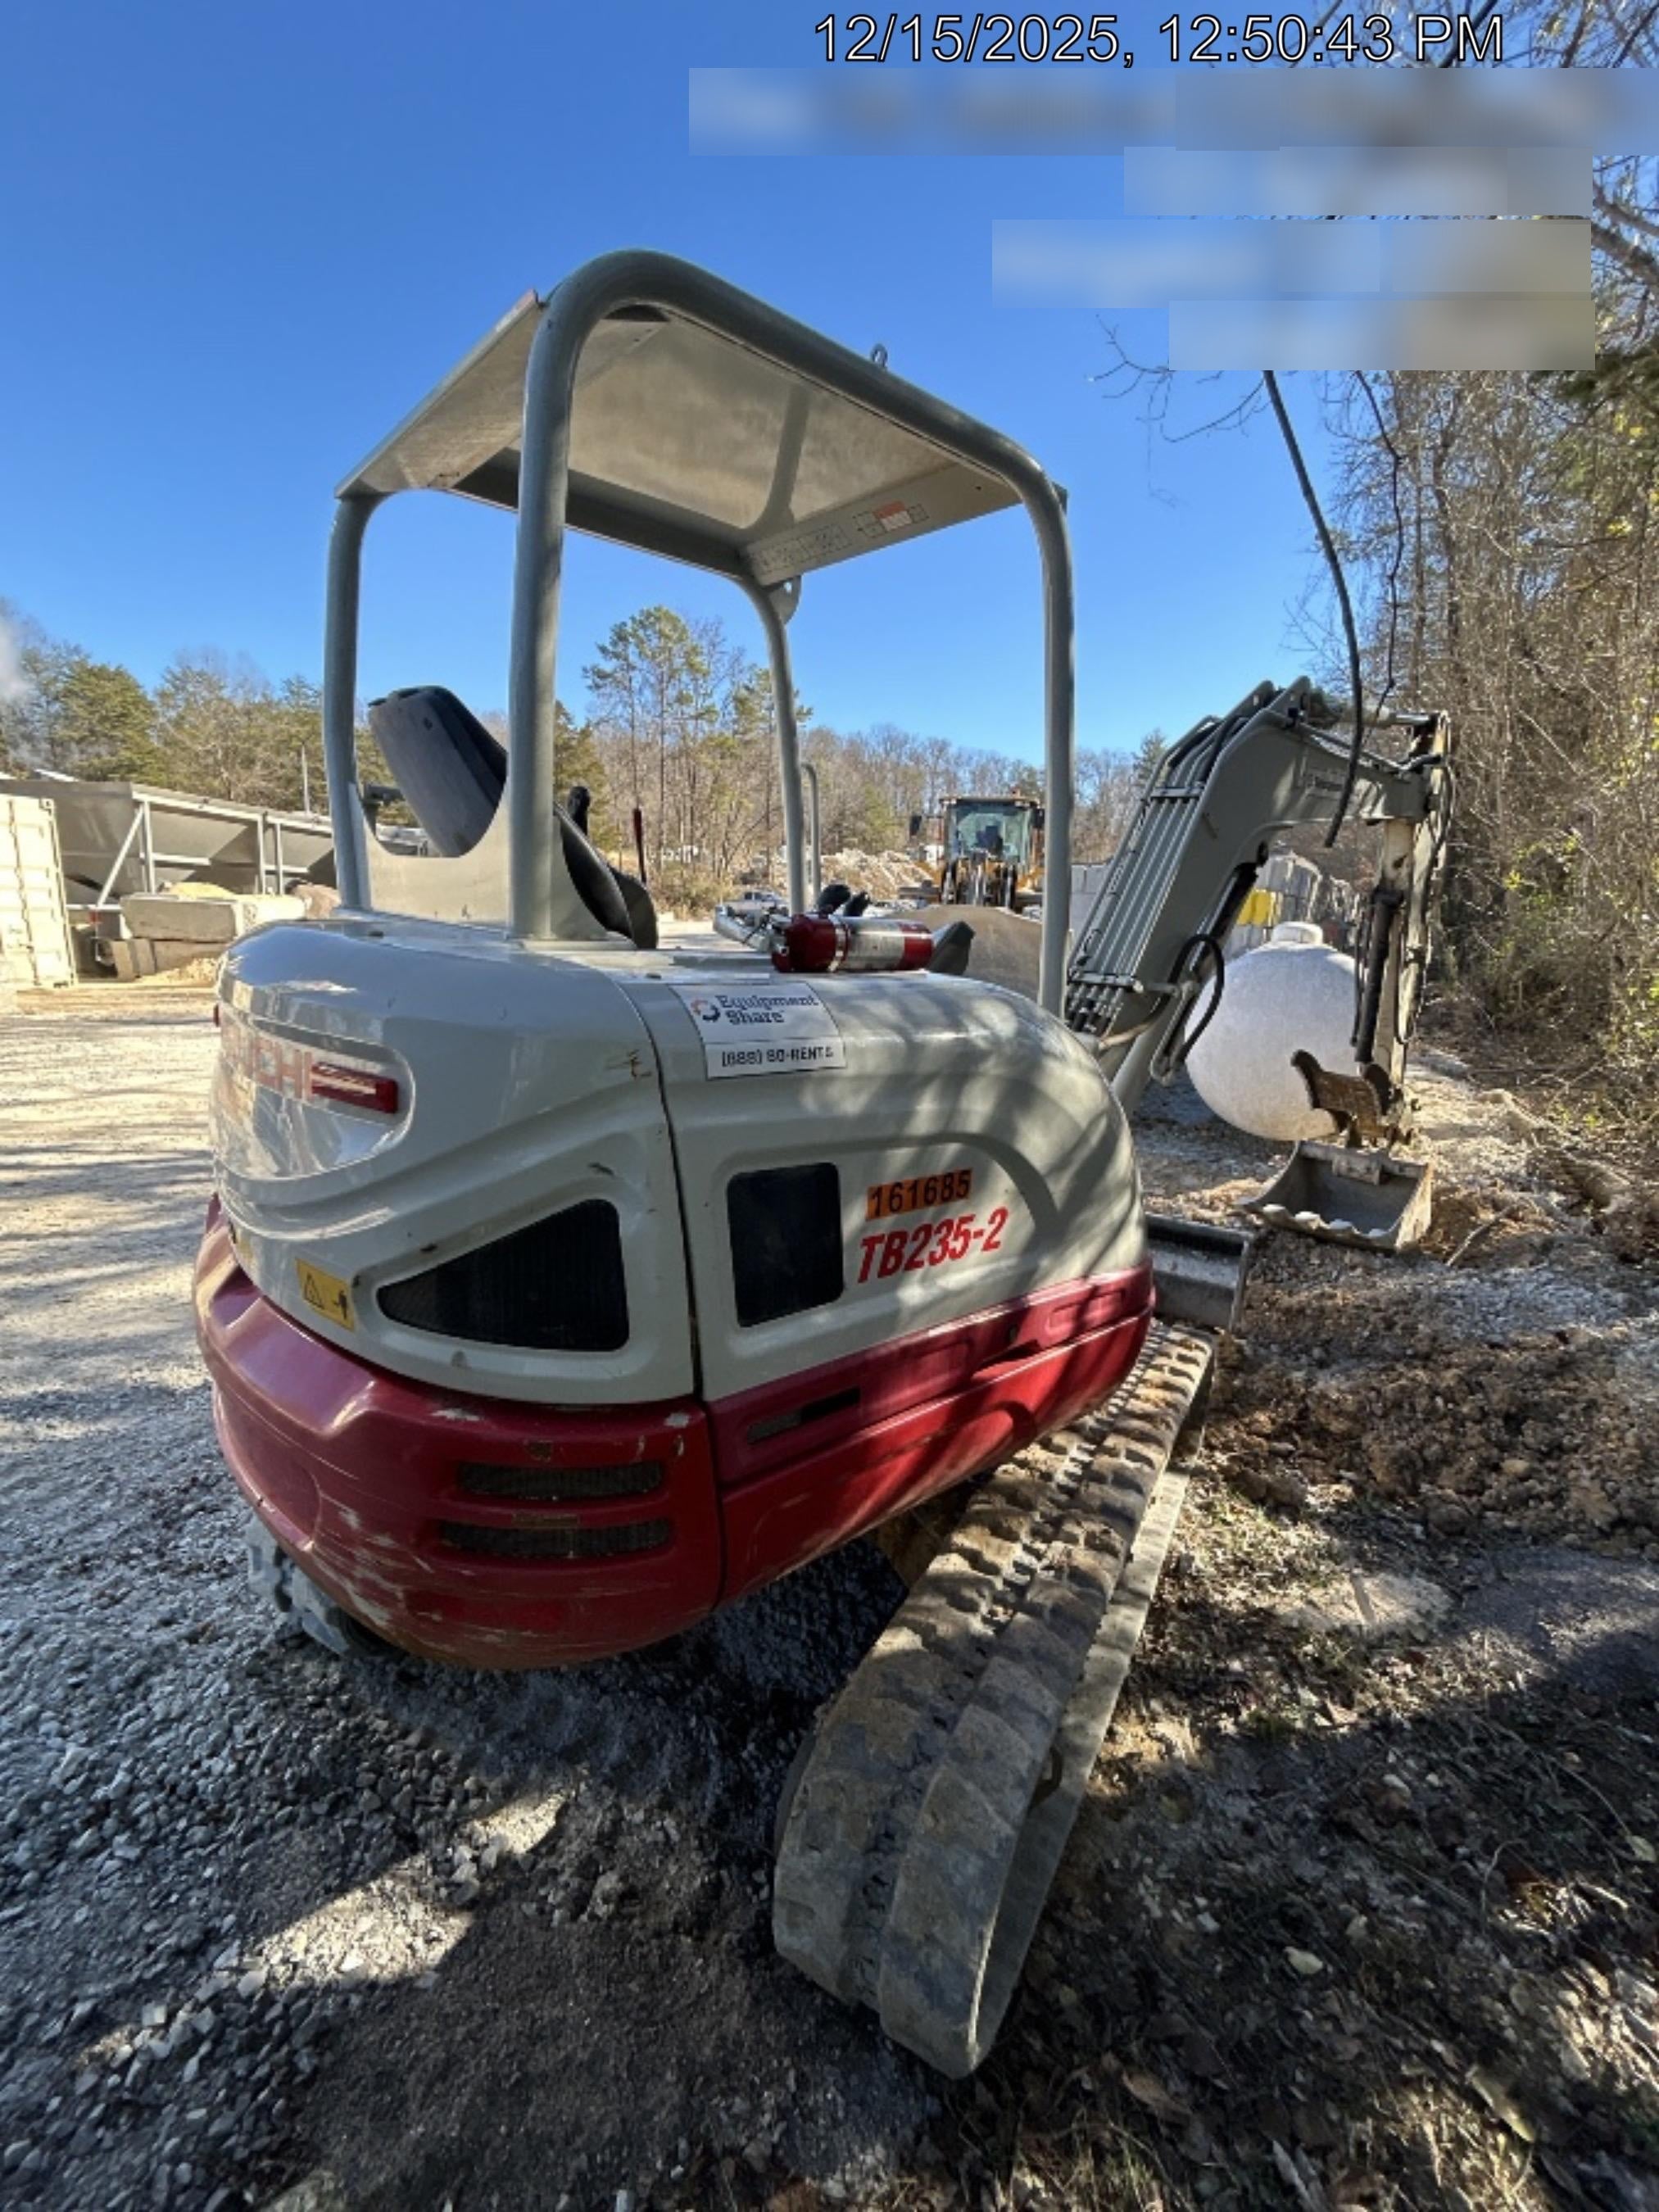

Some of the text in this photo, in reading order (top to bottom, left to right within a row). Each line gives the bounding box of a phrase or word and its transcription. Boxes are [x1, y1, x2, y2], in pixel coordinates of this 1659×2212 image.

[715, 994, 819, 1010] Equipment
[726, 1010, 784, 1025] Share
[871, 1169, 972, 1217] 161685
[858, 1205, 1009, 1285] TB235-2
